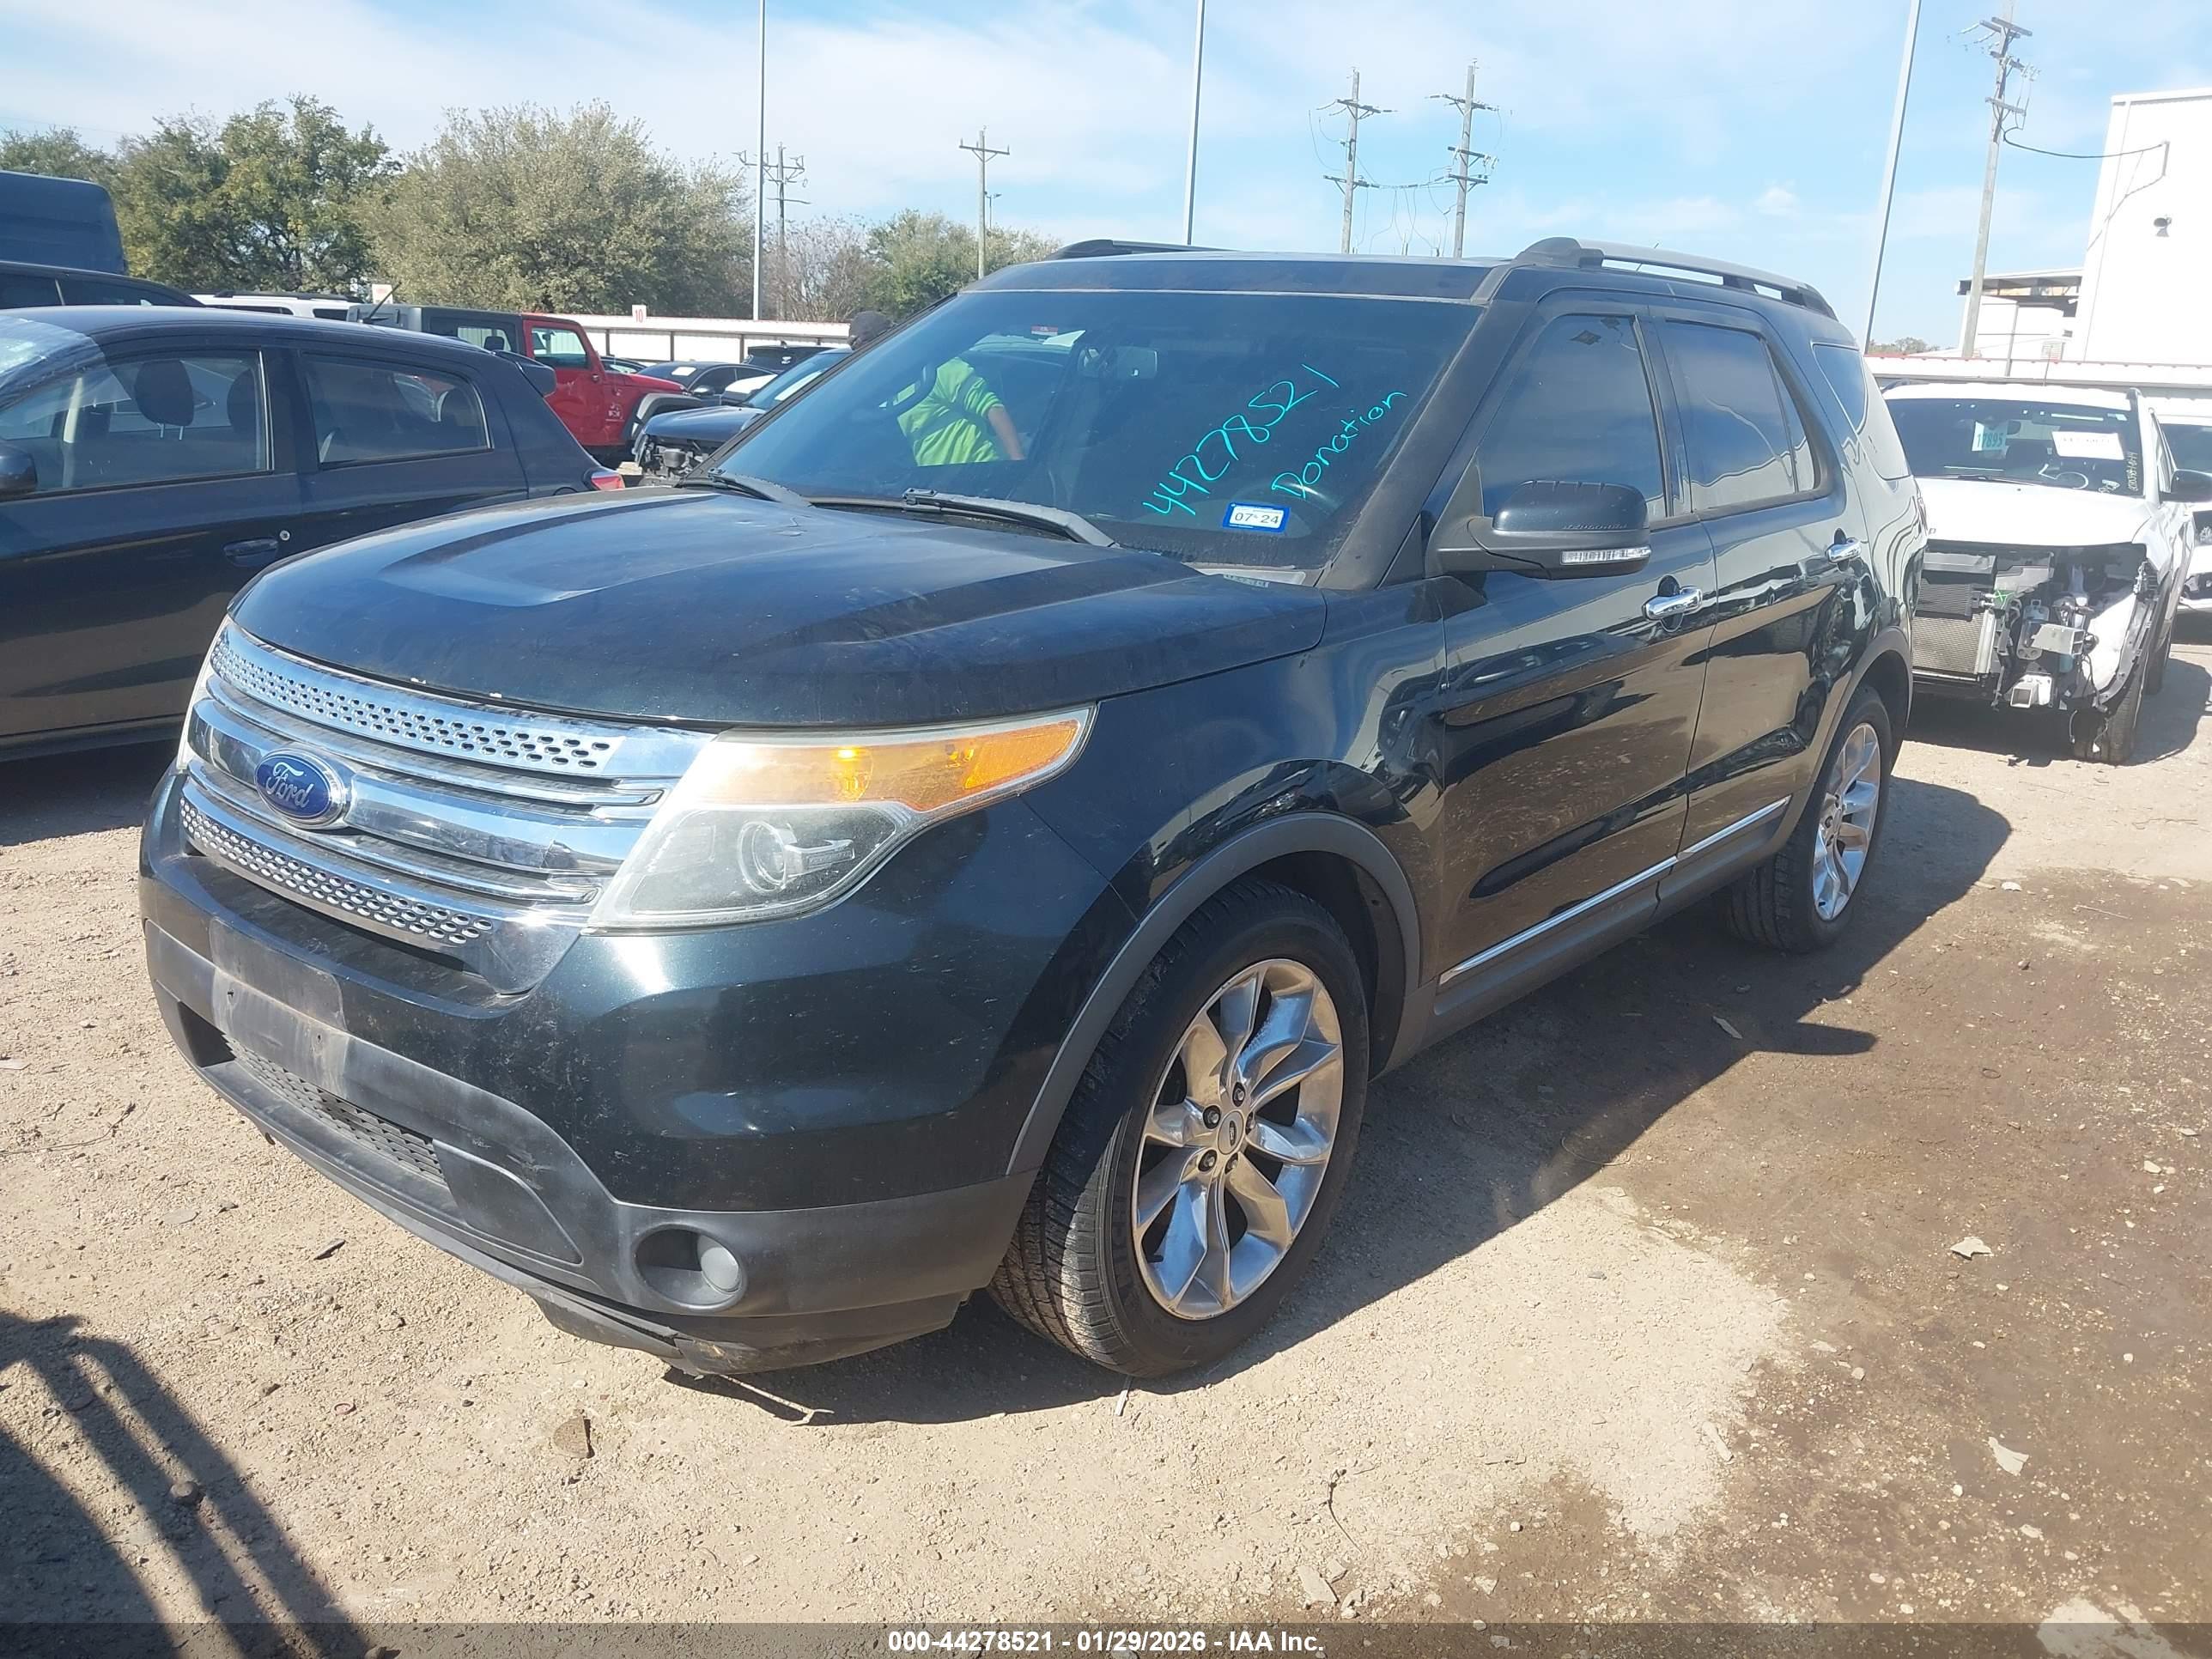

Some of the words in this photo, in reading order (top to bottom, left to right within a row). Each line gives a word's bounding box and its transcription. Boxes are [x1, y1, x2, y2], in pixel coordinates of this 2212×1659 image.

[635, 308, 644, 323] 10
[1142, 363, 1340, 515] 44278521
[1271, 391, 1408, 499] Donation
[1977, 432, 2004, 448] 17895
[1260, 514, 1279, 524] 24
[265, 762, 314, 808] Ford
